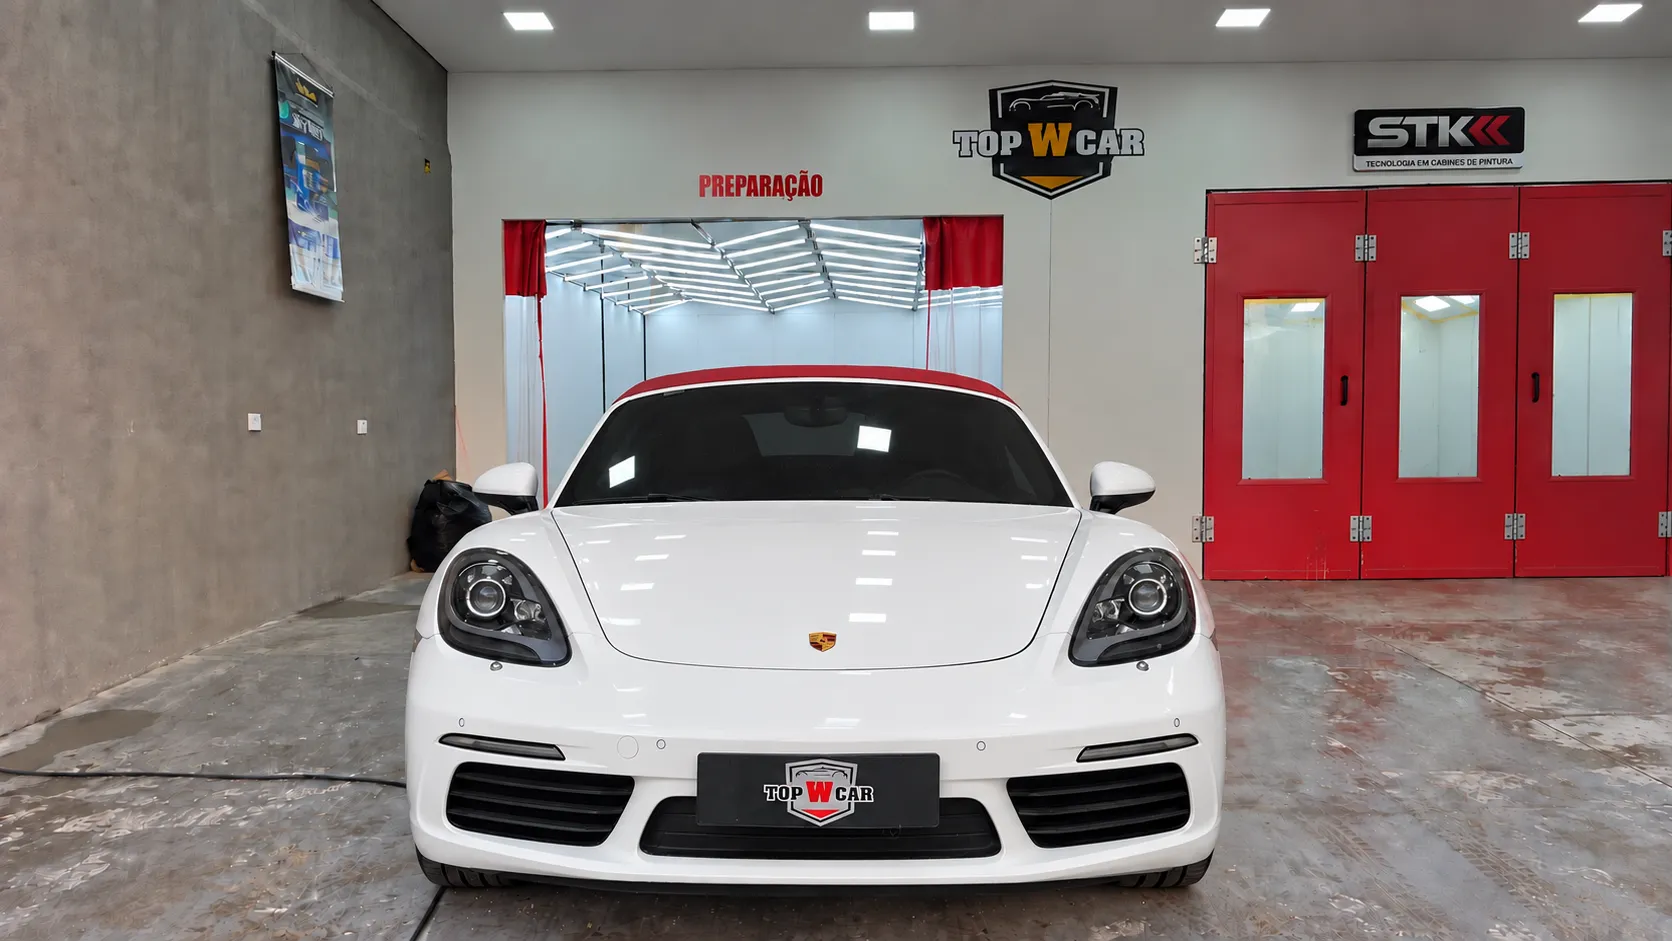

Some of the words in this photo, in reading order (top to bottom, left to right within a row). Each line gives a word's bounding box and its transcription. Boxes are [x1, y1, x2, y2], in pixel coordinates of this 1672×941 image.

[953, 130, 1023, 157] TOP
[1027, 122, 1072, 157] W
[1075, 129, 1144, 156] CAR
[1367, 115, 1475, 148] STK
[1365, 159, 1416, 168] TECNOLOGIA
[1417, 159, 1430, 167] EM
[1431, 158, 1466, 167] CABINES
[1467, 158, 1478, 166] DE
[1479, 157, 1514, 166] PINTURA
[699, 169, 823, 201] PREPARAÇÃO
[764, 784, 804, 802] TOP
[805, 780, 834, 803] W
[835, 785, 874, 802] CAR
